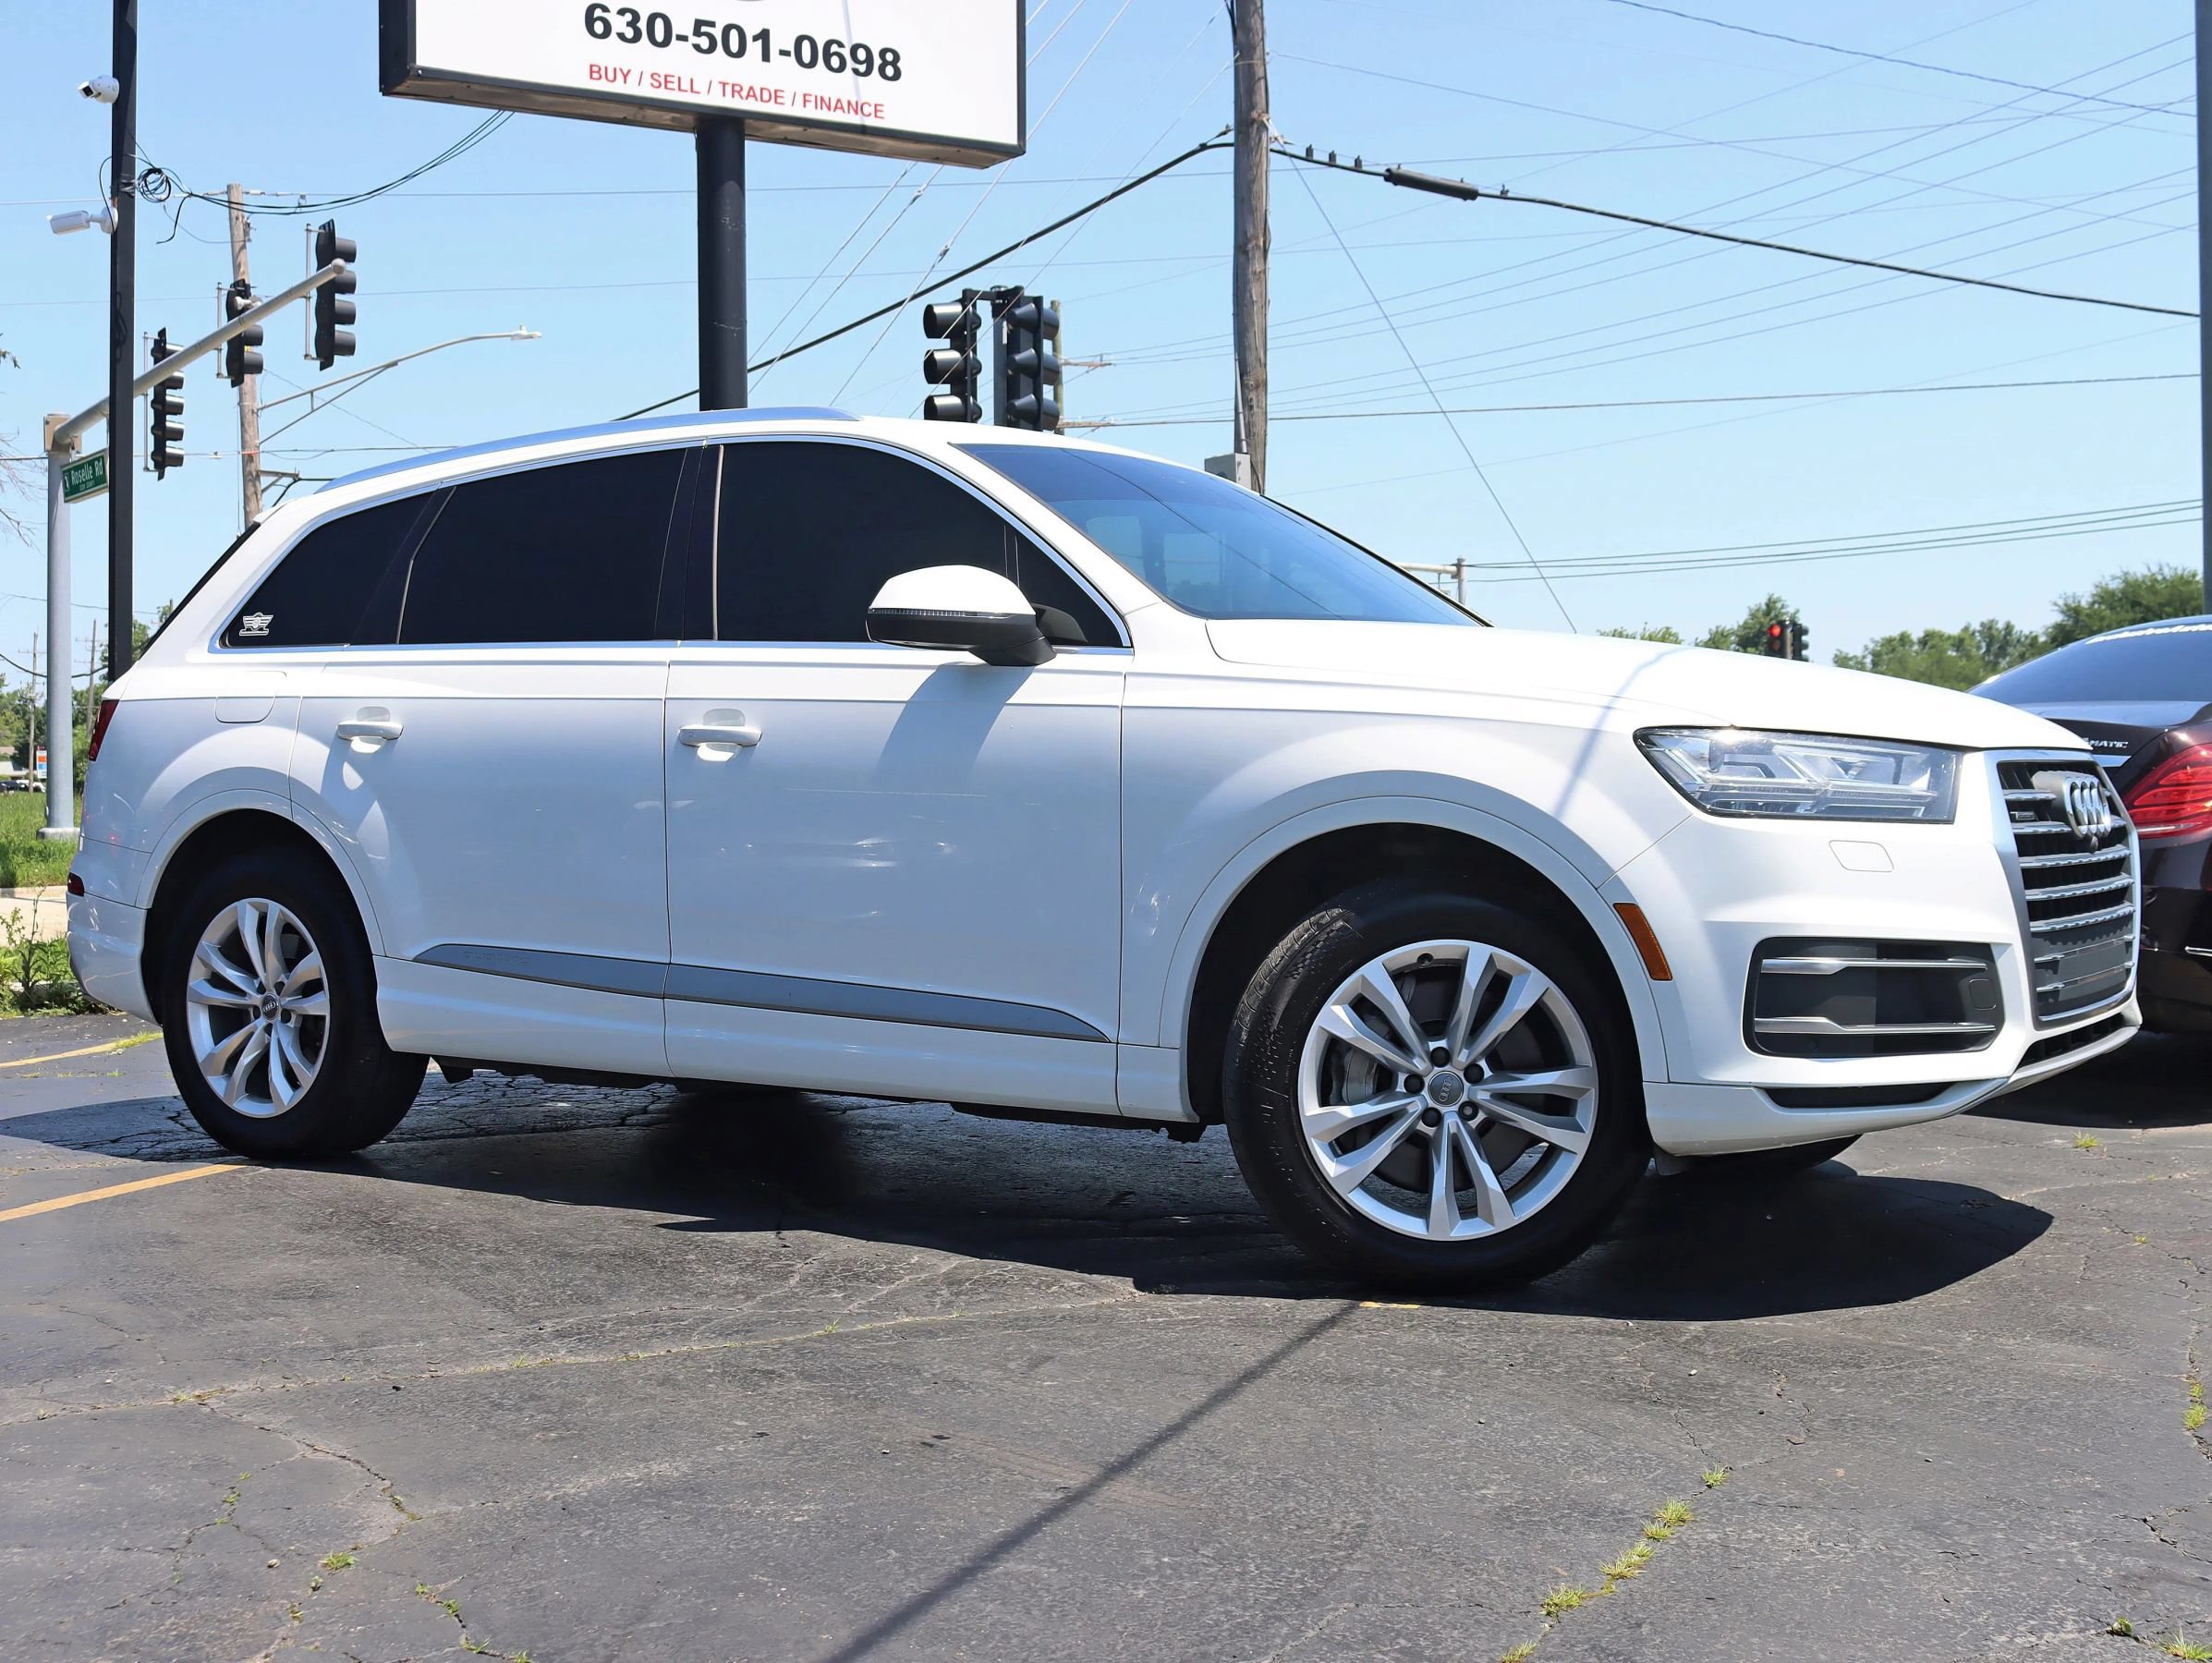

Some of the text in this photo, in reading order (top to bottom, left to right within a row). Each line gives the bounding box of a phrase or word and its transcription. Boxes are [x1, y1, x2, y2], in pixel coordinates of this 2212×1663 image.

[584, 3, 902, 82] 630-501-0698
[589, 64, 631, 84] BUY
[650, 72, 700, 94] SELL
[719, 81, 785, 105] TRADE
[803, 93, 885, 119] FINANCE
[71, 457, 103, 485] Roselle Rd
